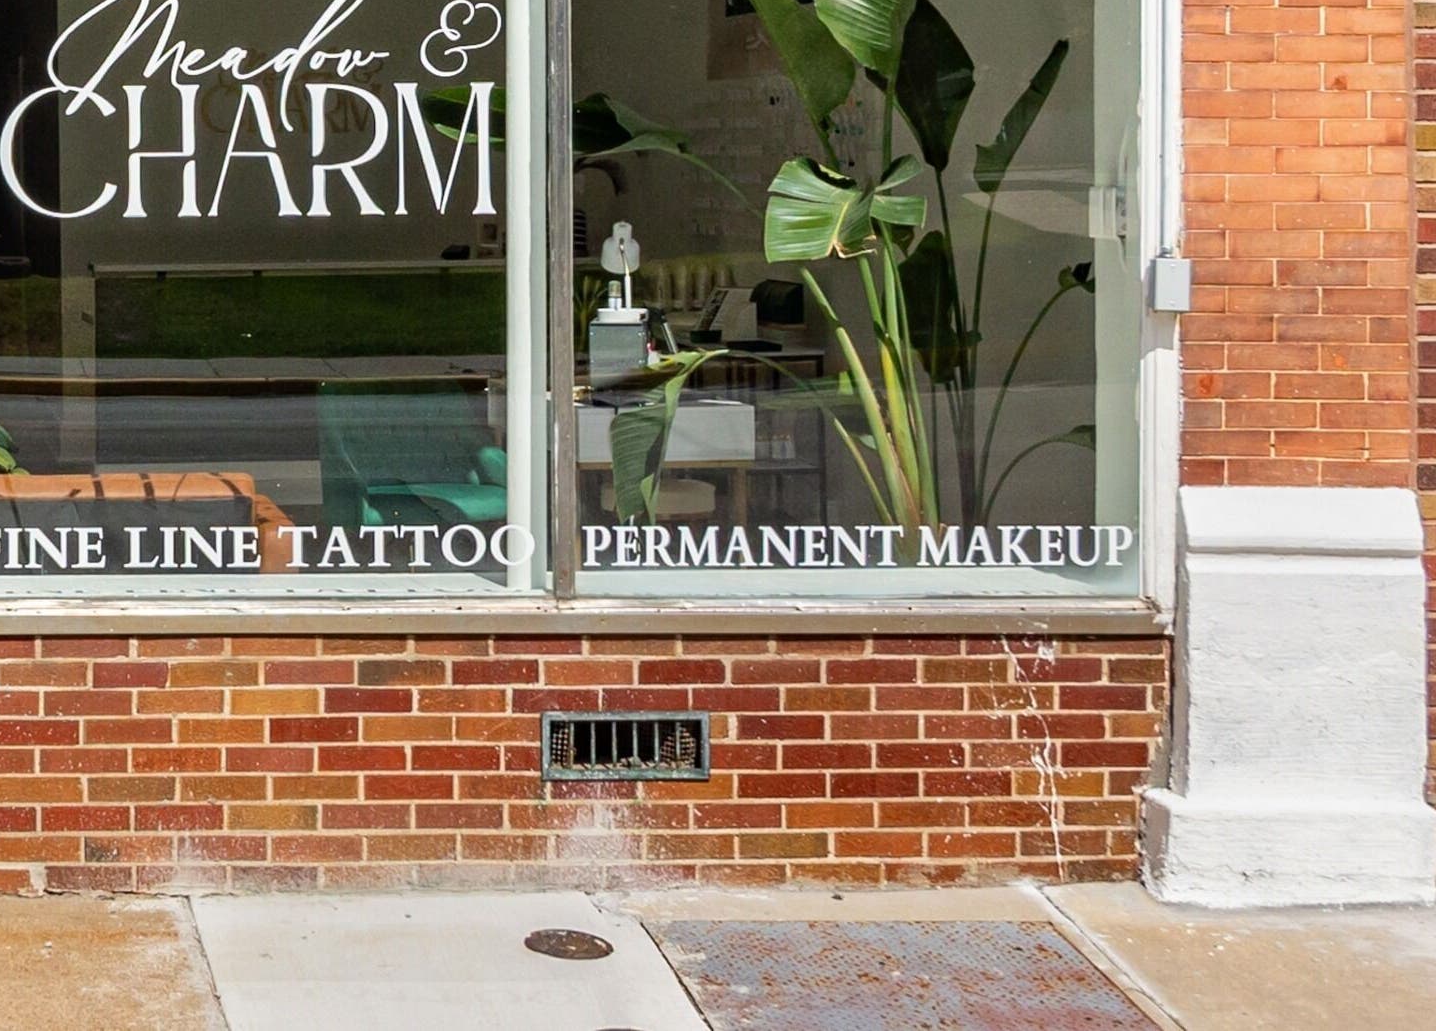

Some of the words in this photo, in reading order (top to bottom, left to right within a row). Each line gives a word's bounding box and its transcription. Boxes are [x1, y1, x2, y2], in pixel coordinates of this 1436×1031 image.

[419, 0, 503, 78] &
[123, 526, 262, 569] LINE
[277, 523, 536, 568] TATTOO
[581, 525, 904, 567] PERMANENT
[917, 525, 1134, 568] MAKEUP
